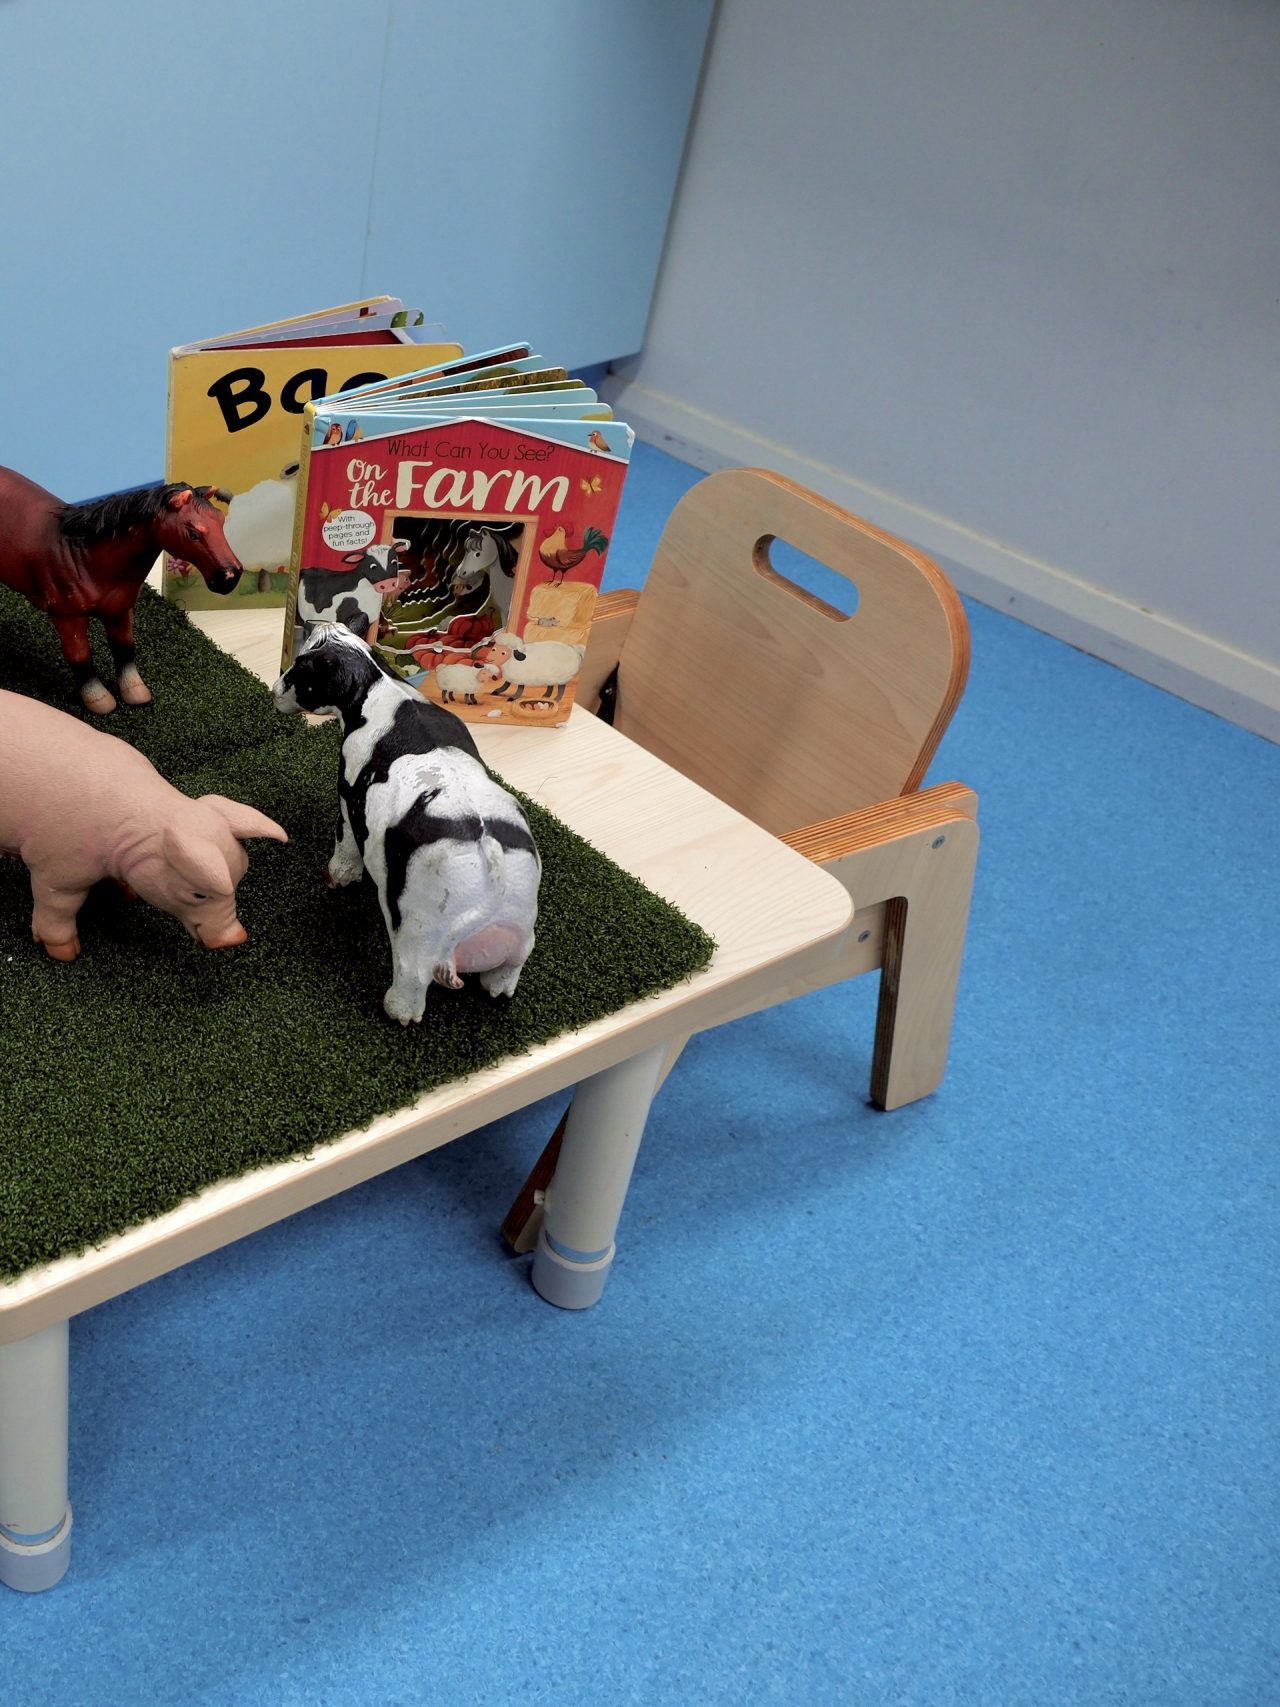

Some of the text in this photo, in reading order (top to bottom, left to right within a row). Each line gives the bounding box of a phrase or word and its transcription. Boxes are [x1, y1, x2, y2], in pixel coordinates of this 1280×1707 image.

[387, 439, 556, 462] What Can You See?
[346, 458, 388, 482] On
[348, 480, 394, 508] the
[395, 460, 570, 513] Farm
[324, 520, 375, 533] peep-through
[328, 532, 353, 540] pages
[346, 538, 368, 546] facts!
